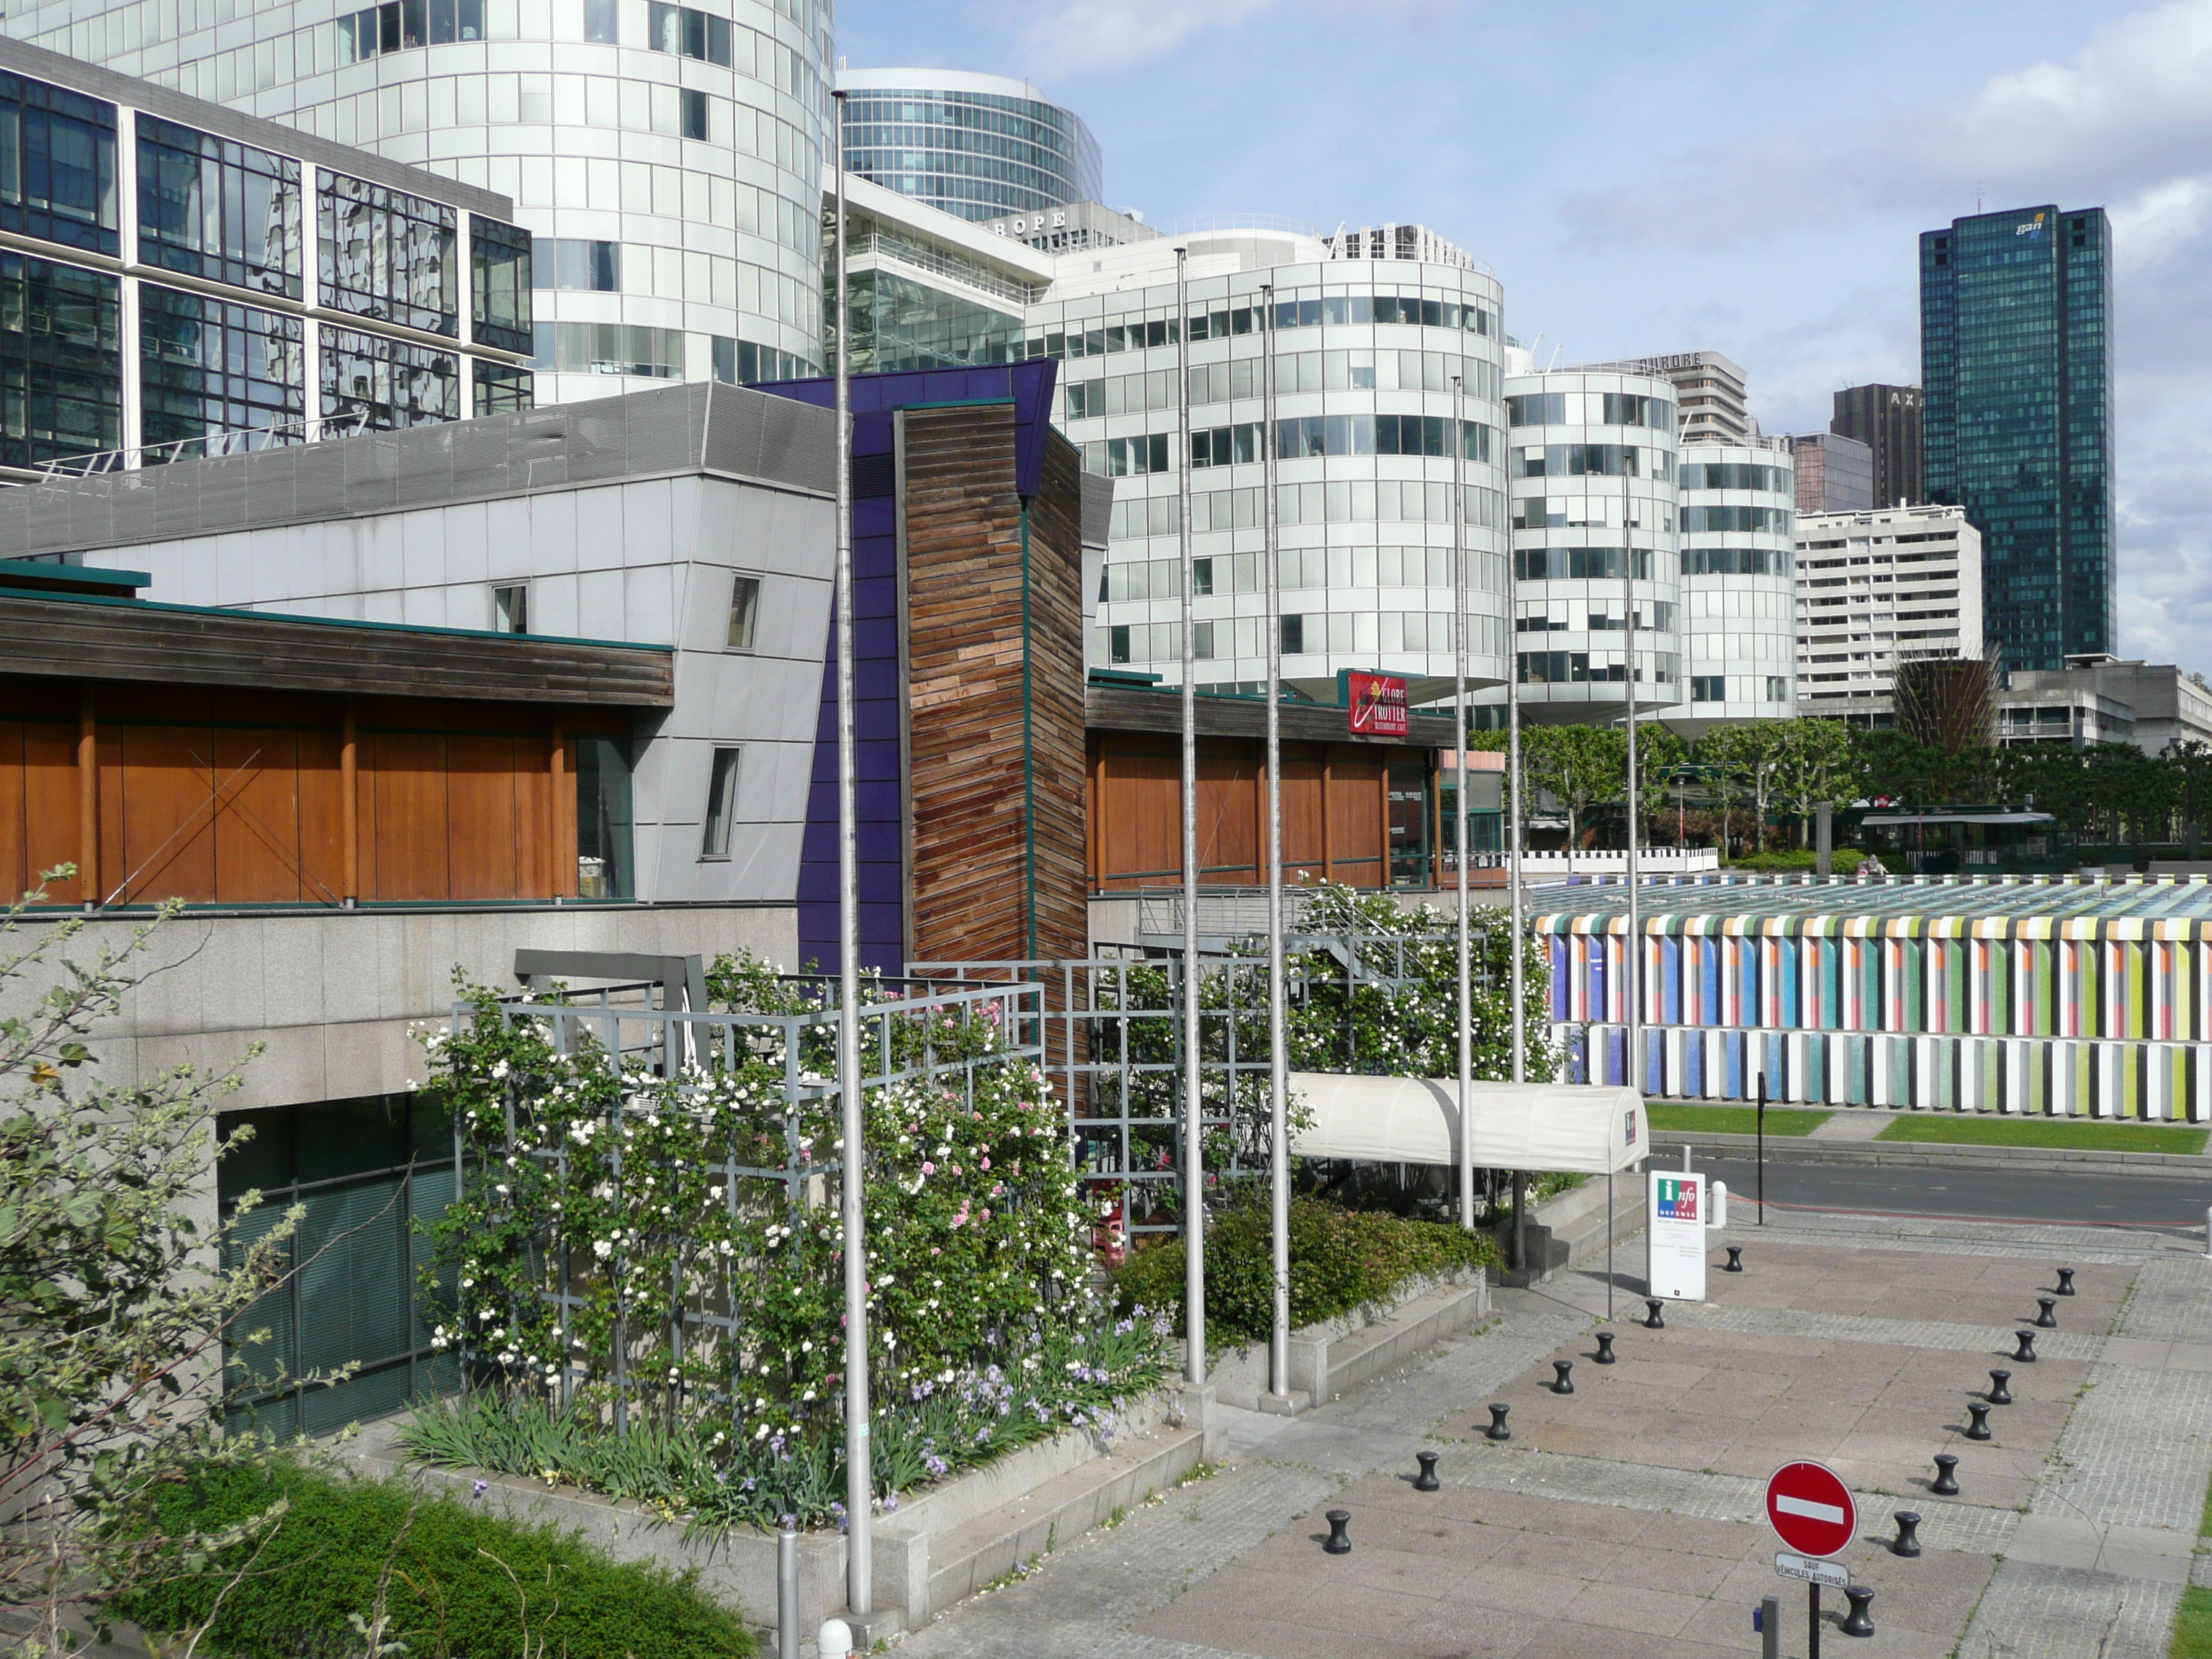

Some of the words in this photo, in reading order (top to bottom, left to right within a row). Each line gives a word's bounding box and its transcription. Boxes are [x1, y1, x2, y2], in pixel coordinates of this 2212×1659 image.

[985, 212, 1066, 237] ROPE
[2015, 222, 2042, 235] gan
[1640, 352, 1701, 371] AURORE
[1382, 688, 1405, 704] GLOBE
[1374, 704, 1406, 721] TROTTER
[1665, 1180, 1695, 1209] info
[1804, 1560, 1820, 1570] SAUF
[1776, 1564, 1809, 1578] VÉHICULES
[1812, 1573, 1845, 1586] AUTORISÉS
